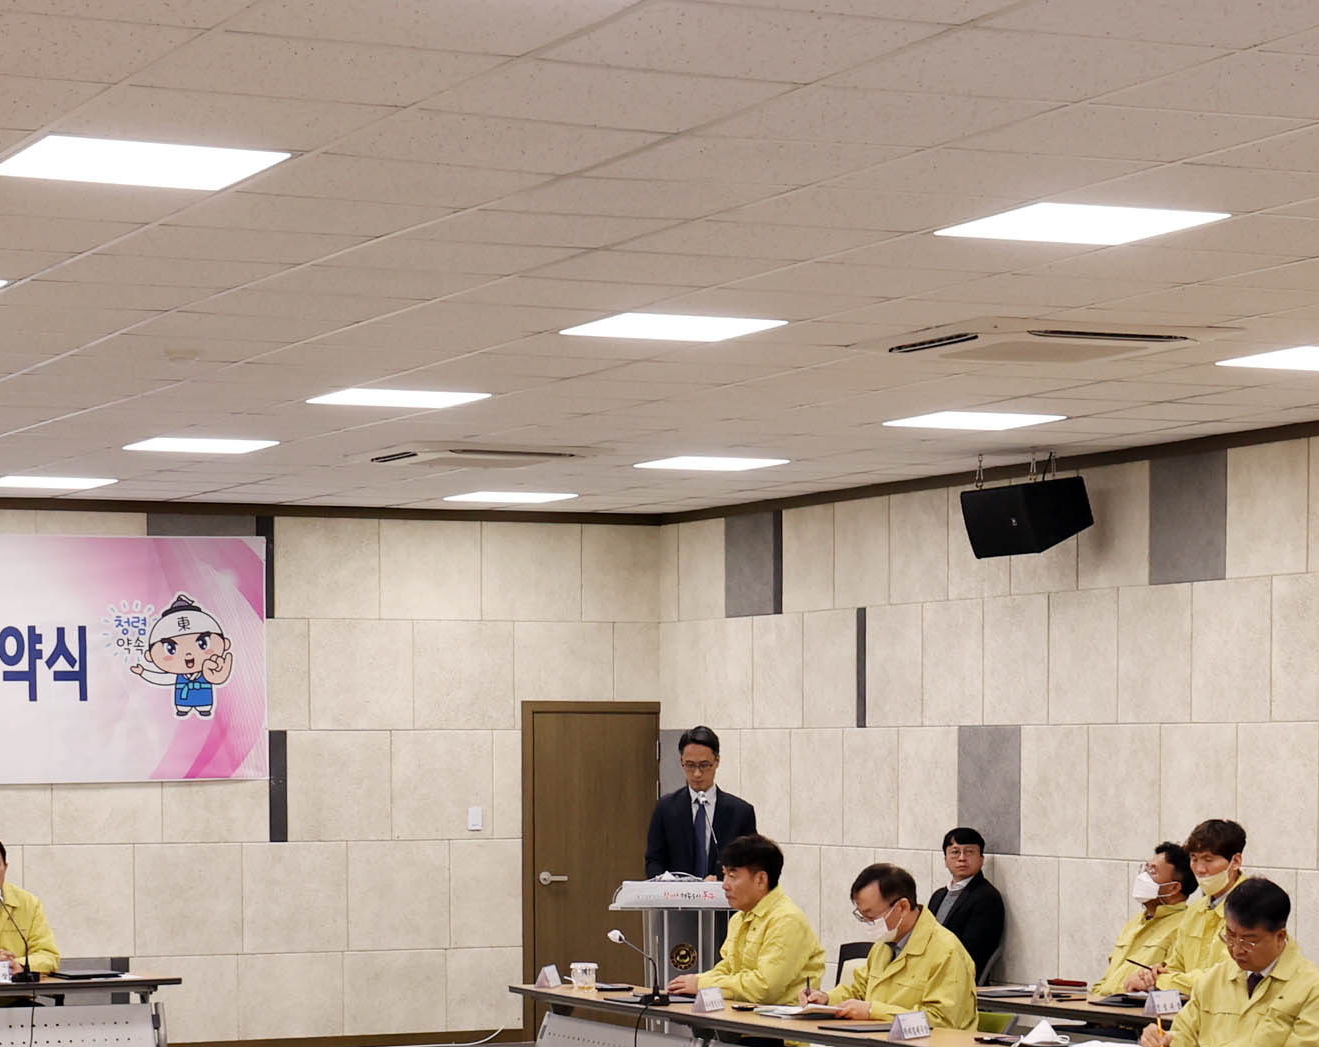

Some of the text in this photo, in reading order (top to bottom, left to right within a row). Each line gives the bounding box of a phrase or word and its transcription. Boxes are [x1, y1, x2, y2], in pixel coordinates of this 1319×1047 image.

[114, 615, 147, 636] 청렴
[176, 616, 192, 632] 東
[116, 636, 146, 655] 약속
